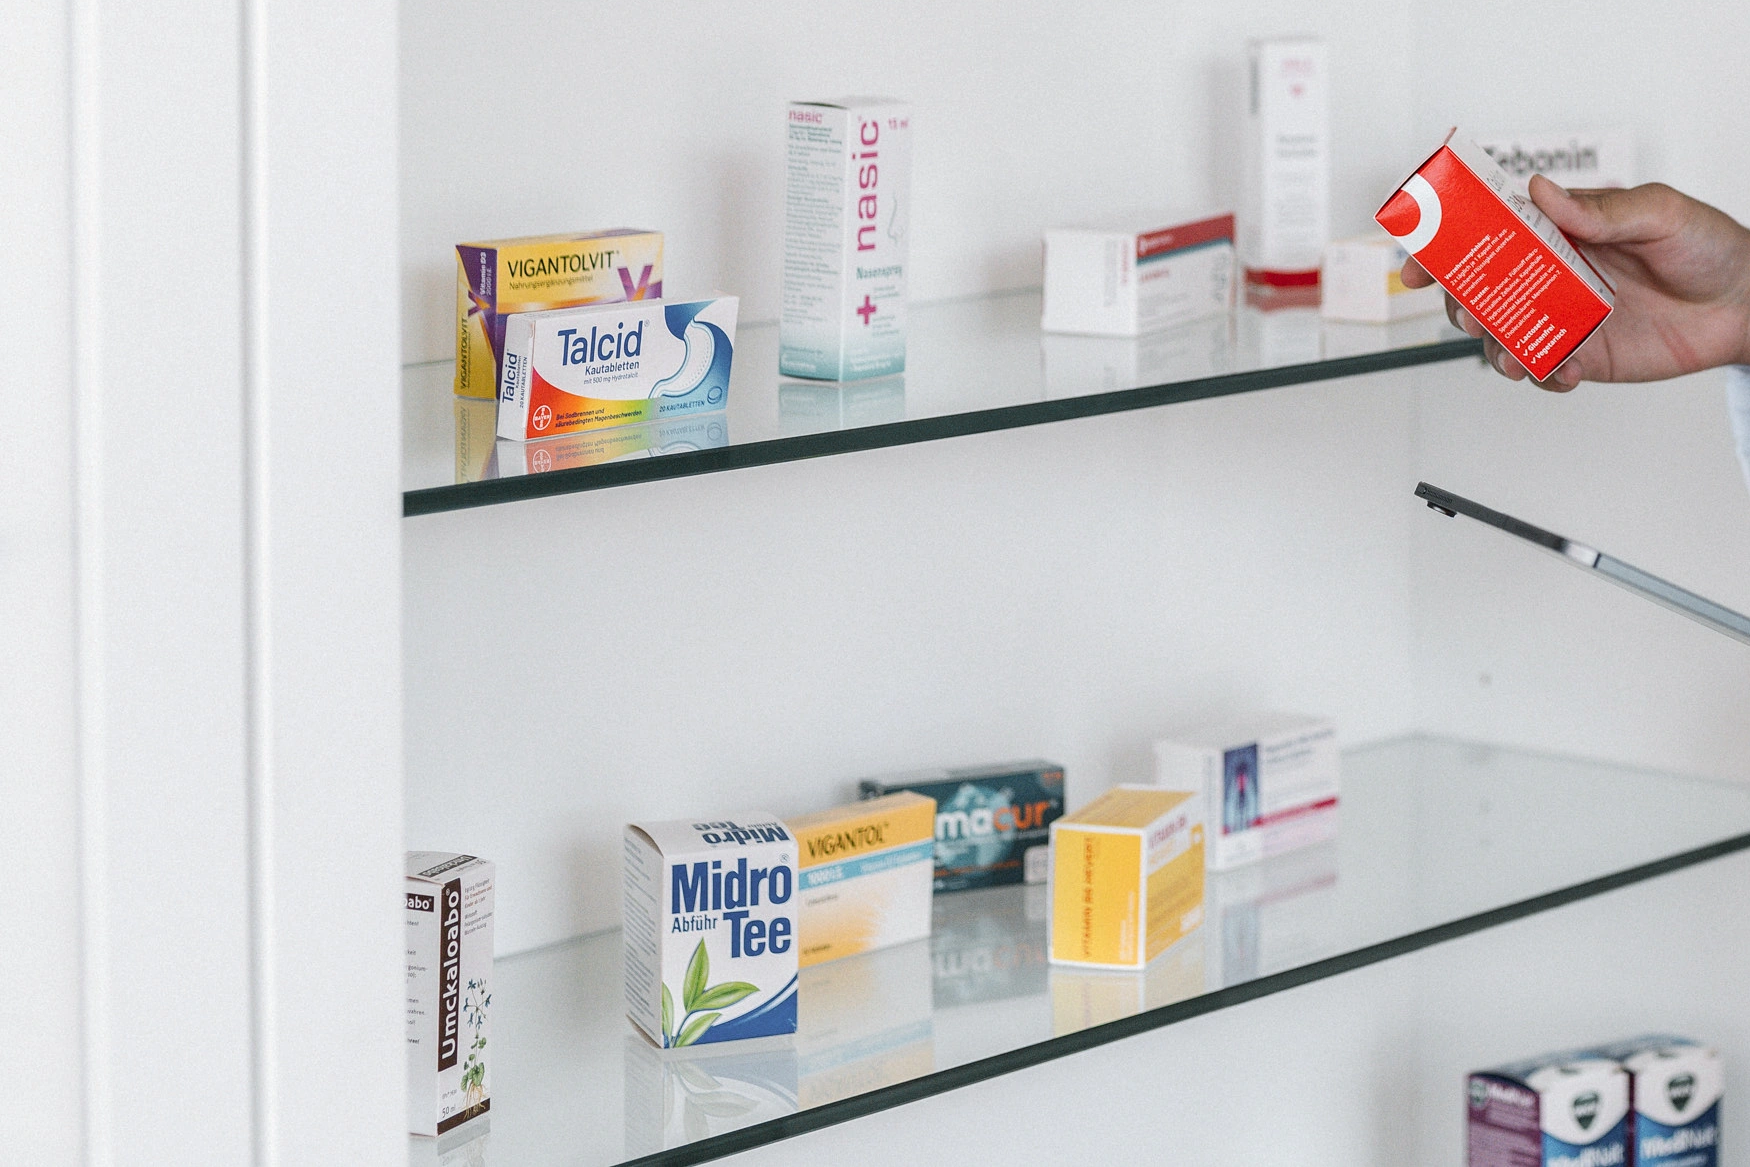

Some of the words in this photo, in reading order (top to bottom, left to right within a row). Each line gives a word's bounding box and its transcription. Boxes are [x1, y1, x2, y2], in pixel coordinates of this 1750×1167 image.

[788, 110, 822, 124] nasic
[1483, 143, 1598, 175] ebonin
[852, 120, 879, 251] nasic
[507, 250, 614, 278] VIGANTOLVIT
[1455, 271, 1475, 291] reichend
[1494, 230, 1516, 252] unzerkaut
[1476, 243, 1493, 259] Kapsel
[1508, 259, 1526, 277] Füllstoff
[1514, 271, 1549, 306] Magnesiumsalze
[558, 320, 643, 366] Talcid
[1519, 313, 1549, 344] Lactosefrei
[1527, 323, 1555, 351] Glutenfrei
[1535, 327, 1567, 359] Vegetarisch
[500, 352, 518, 403] Talcid
[520, 356, 528, 400] KAUTABLETTEN
[585, 361, 639, 376] Kautabletten
[611, 372, 638, 381] Hydrotalcit
[555, 418, 594, 428] säurebedingten
[594, 410, 642, 422] Magenbeschwerden
[564, 410, 594, 419] Sodbrennen
[667, 400, 705, 411] KAUTABLETTEN
[702, 826, 790, 845] Midro
[807, 824, 884, 858] VIGANTOL
[671, 857, 792, 915] Midro
[671, 914, 718, 934] Abführ
[722, 910, 791, 958] Tee
[442, 891, 460, 1060] Umckaloabo
